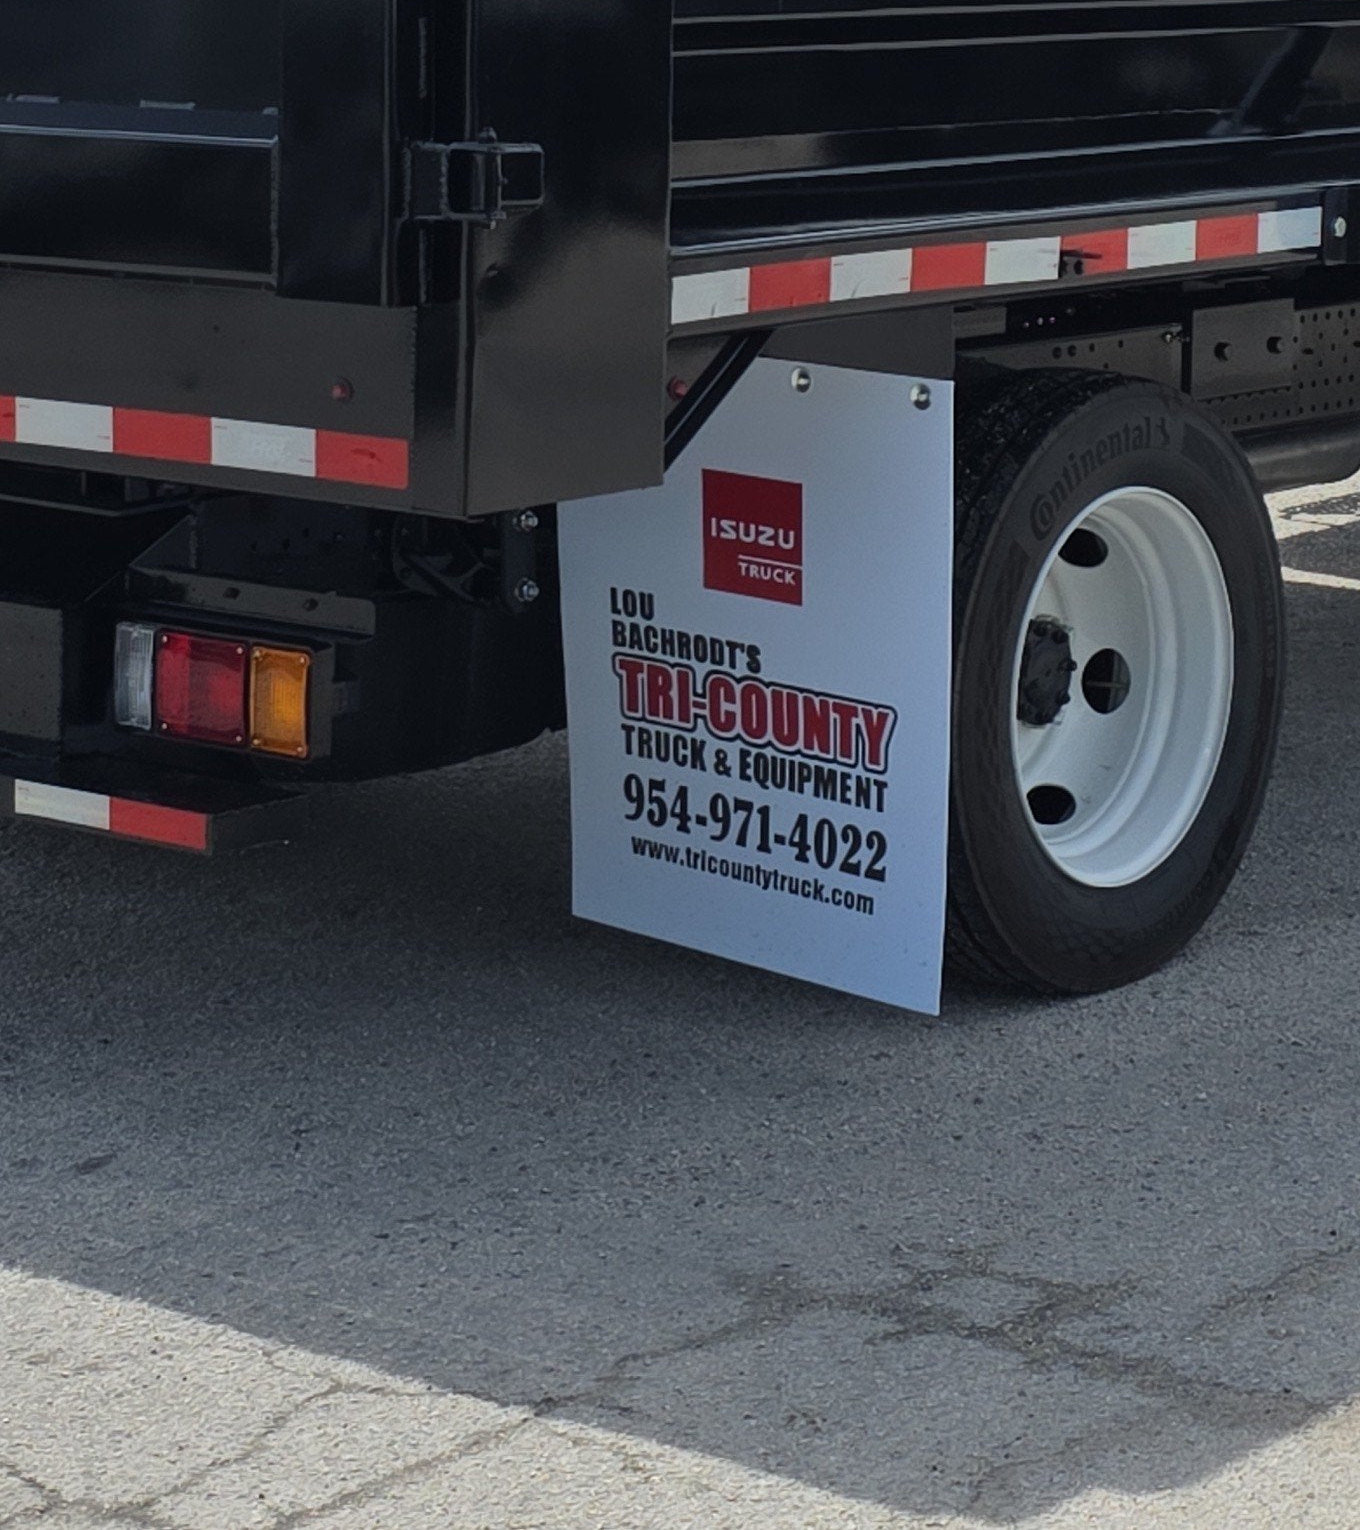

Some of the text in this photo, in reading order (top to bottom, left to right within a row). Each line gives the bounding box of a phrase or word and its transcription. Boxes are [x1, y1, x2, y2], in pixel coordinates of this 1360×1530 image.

[1029, 416, 1152, 542] Continental
[710, 516, 796, 550] ISUZU
[737, 561, 796, 586] TRUCK
[610, 586, 655, 621] LOU
[611, 619, 762, 674] BACHRODT'S
[614, 654, 895, 772] TRI-COUNTY
[620, 722, 889, 813] TRUCK & EQUIPMENT
[622, 772, 889, 884] 954-971-4022
[630, 835, 875, 916] www.tricountytruck.com
